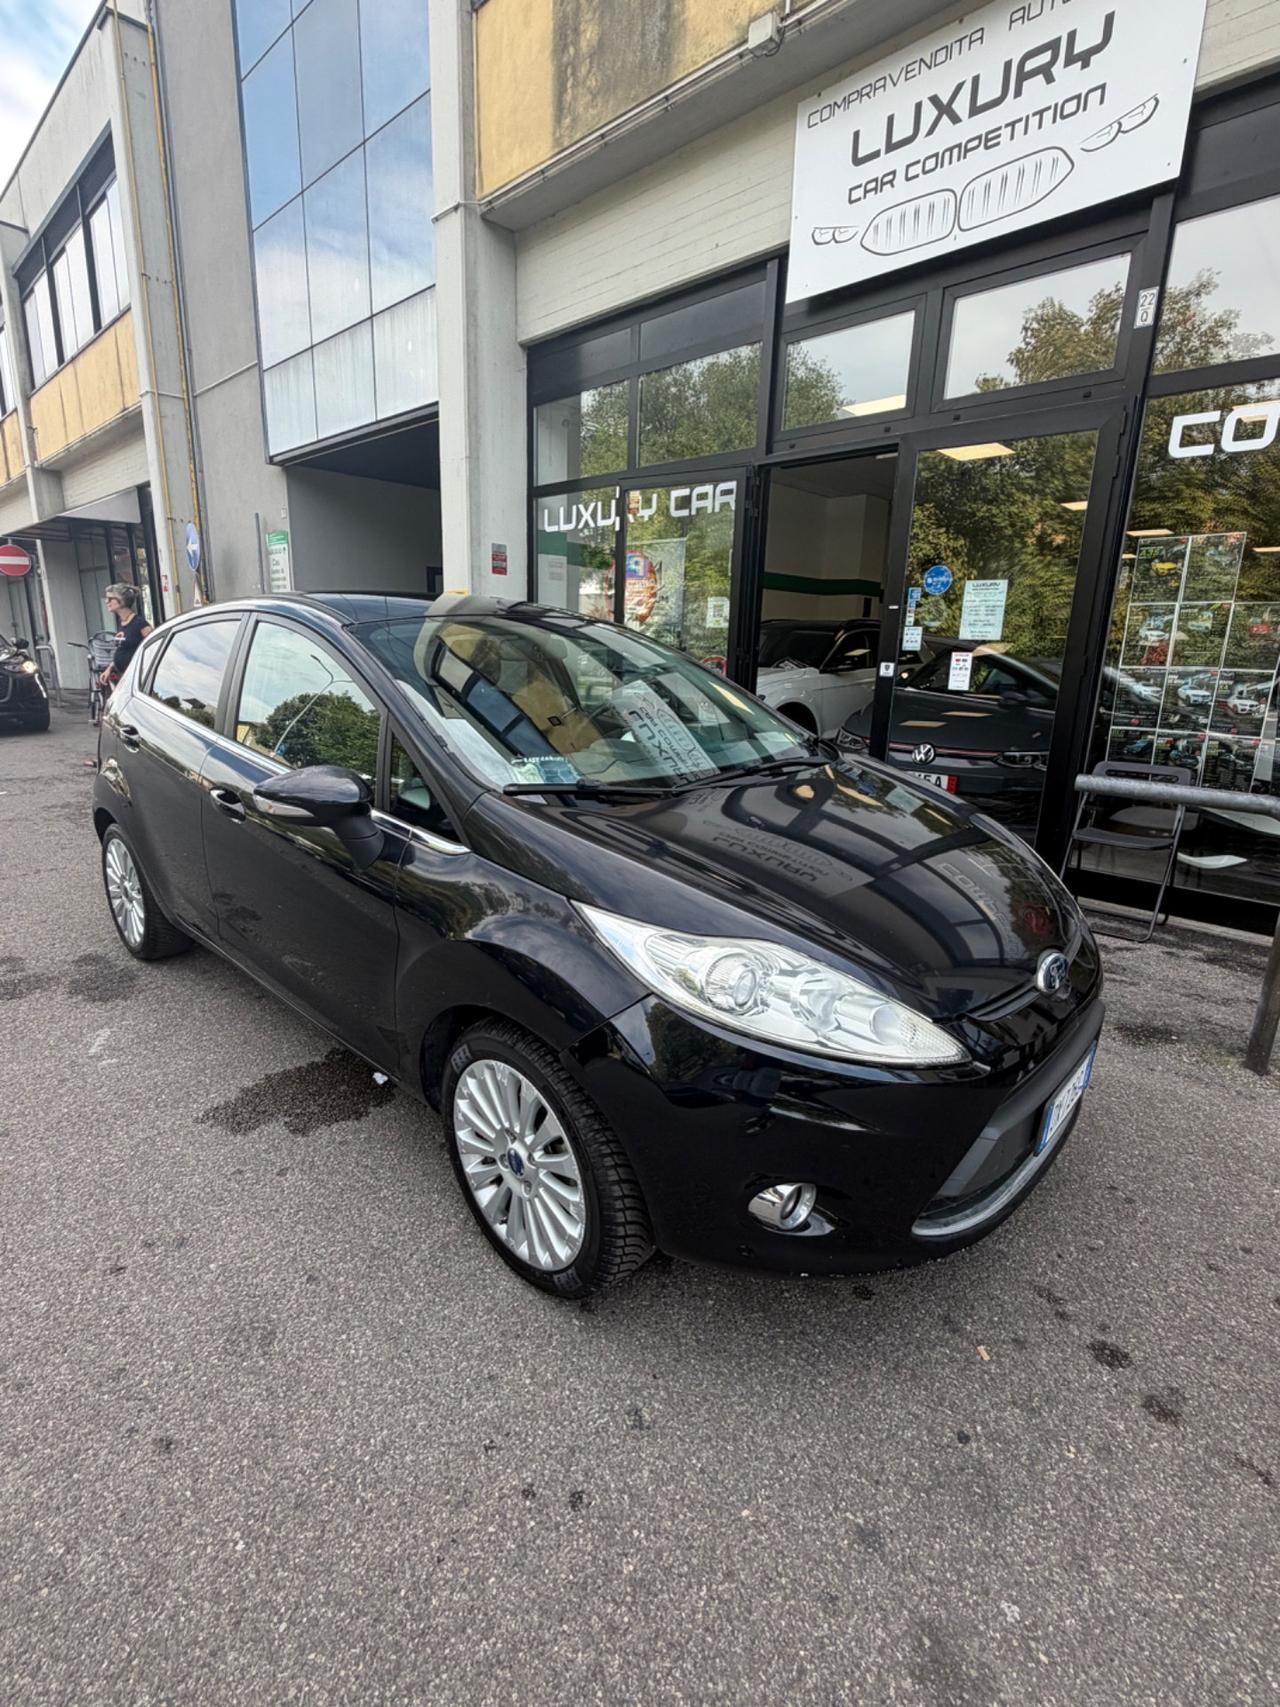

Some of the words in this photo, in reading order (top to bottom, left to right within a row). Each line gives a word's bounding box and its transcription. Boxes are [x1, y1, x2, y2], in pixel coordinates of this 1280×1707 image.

[807, 27, 985, 129] COMPRAVENDITA
[851, 10, 1116, 167] LUXURY
[848, 168, 897, 205] CAR
[904, 82, 1107, 182] COMPETITION
[1140, 292, 1156, 307] 22
[669, 480, 738, 518] CAR
